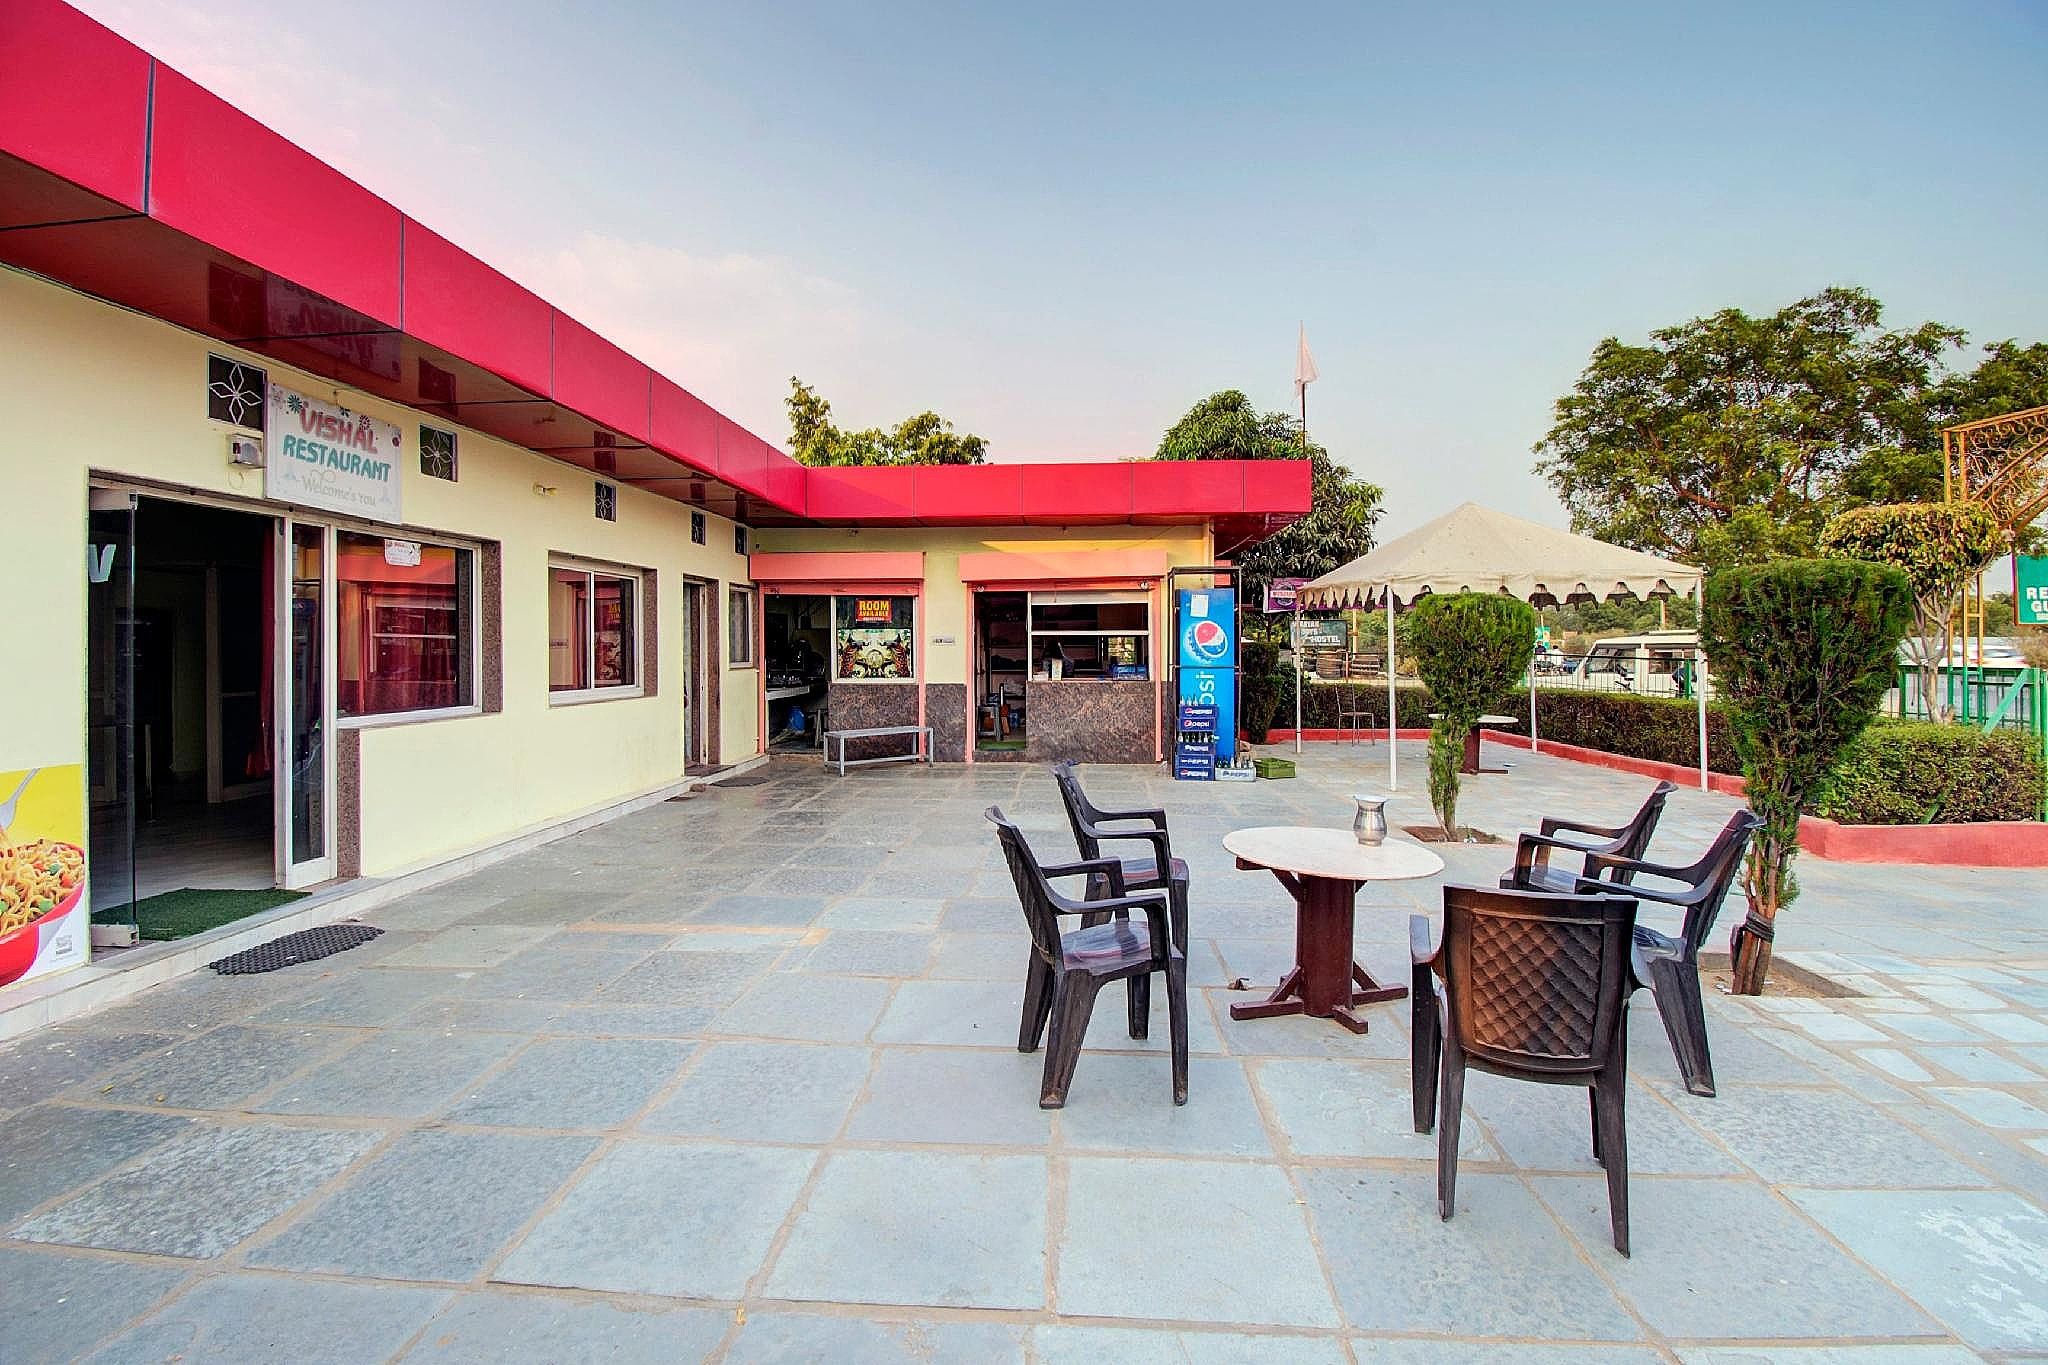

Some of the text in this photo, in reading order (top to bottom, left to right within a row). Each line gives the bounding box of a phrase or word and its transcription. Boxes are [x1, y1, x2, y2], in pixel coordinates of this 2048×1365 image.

[300, 406, 378, 454] VISHAL
[282, 434, 392, 482] RESTAURANT
[858, 600, 889, 611] ROOM
